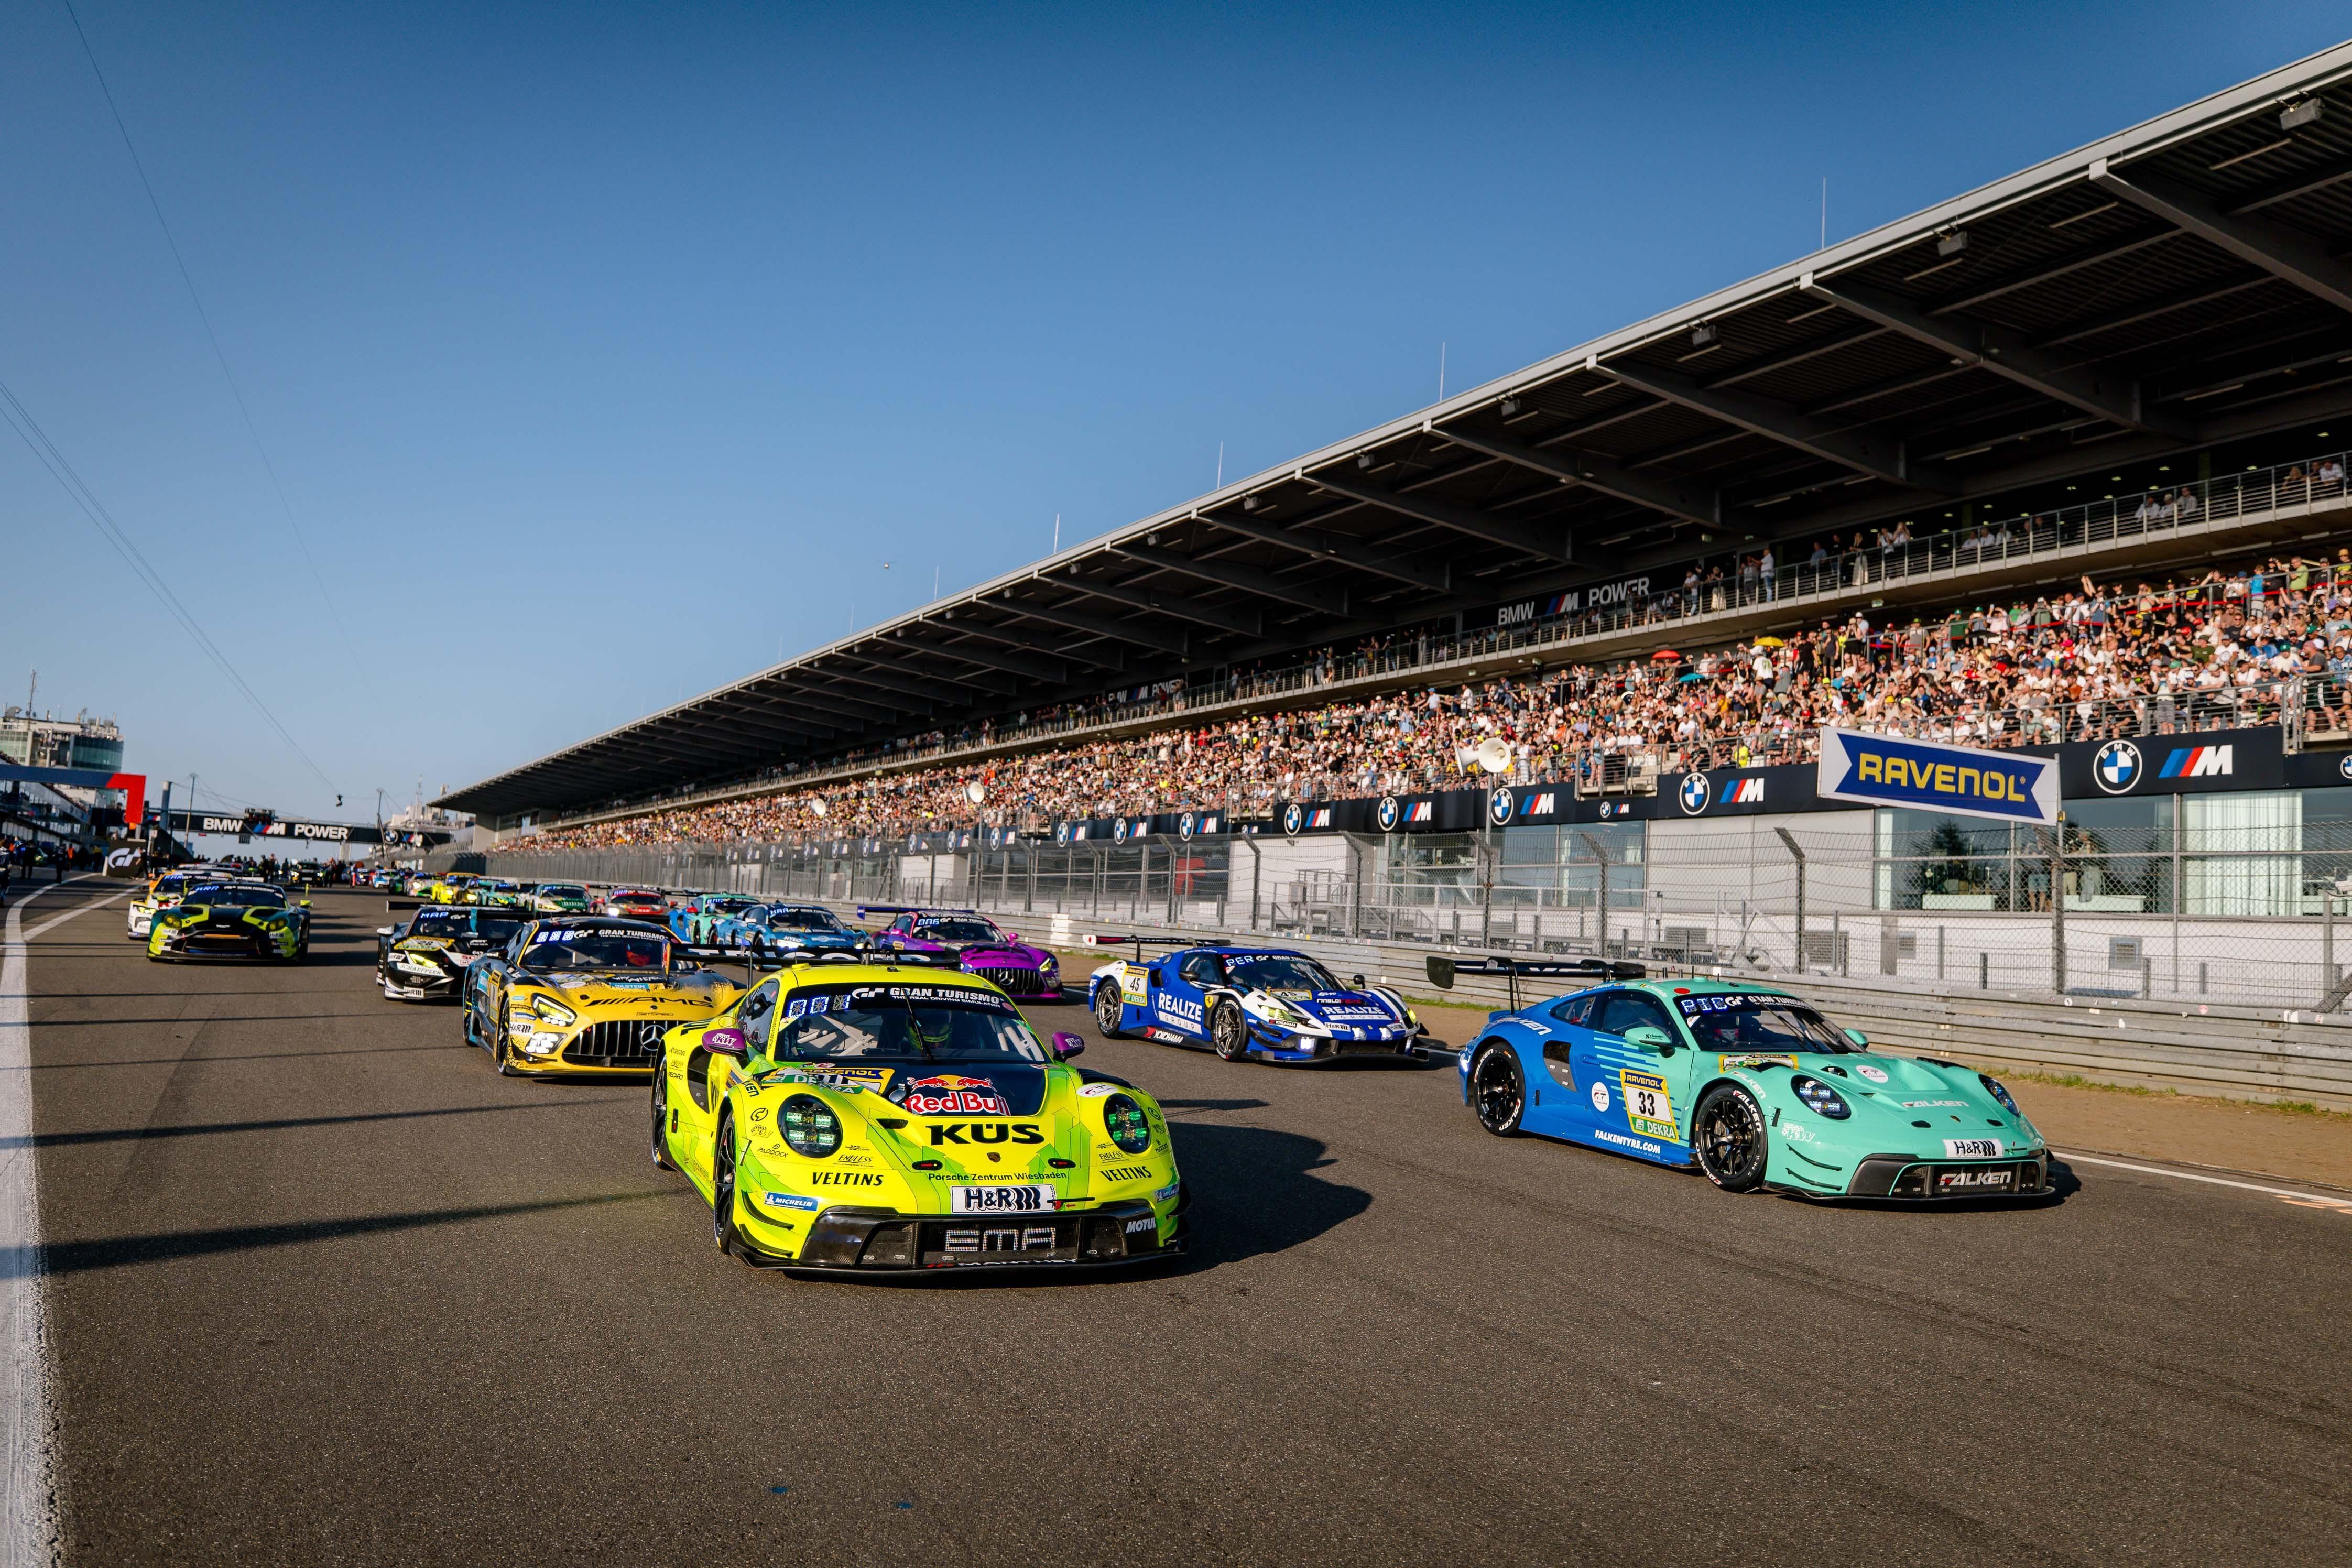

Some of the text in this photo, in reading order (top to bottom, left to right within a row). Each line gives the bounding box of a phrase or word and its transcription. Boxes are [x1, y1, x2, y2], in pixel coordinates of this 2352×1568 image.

[1498, 601, 1534, 625] BMW
[1588, 578, 1650, 607] POWER
[2101, 743, 2136, 759] BMW
[1684, 775, 1707, 787] BMW
[1859, 753, 2026, 802] RAVENOL
[203, 817, 243, 832] BMW
[294, 823, 349, 840] POWER
[626, 930, 665, 940] TURISMO
[1225, 955, 1254, 966] PER
[400, 963, 442, 975] SCHAEFFLER
[1130, 977, 1141, 992] 45
[629, 997, 714, 1008] AMG
[890, 987, 932, 997] GRAN
[937, 988, 1000, 1005] TURISMO
[961, 998, 1001, 1008] SIMULATOR
[1131, 995, 1146, 1004] DEKRA
[1158, 992, 1203, 1022] REALIZE
[1322, 1006, 1385, 1015] REALIZE
[509, 1023, 521, 1032] H&R
[1164, 1014, 1195, 1031] GROUP
[715, 1035, 737, 1046] KW
[1153, 1029, 1184, 1044] YOKOHAMA
[1474, 1048, 1494, 1083] FALKEN
[668, 1071, 683, 1080] RECARO
[1627, 1075, 1661, 1088] RAVENOL
[1732, 1071, 1767, 1100] FALKEN
[906, 1091, 1011, 1116] Red Bull
[1638, 1091, 1656, 1117] 33
[1499, 1098, 1521, 1131] FALKEN
[1733, 1090, 1762, 1133] FALKEN
[925, 1123, 1045, 1146] KÜS
[1647, 1121, 1676, 1139] DEKRA
[1594, 1129, 1661, 1155] FALKENTYRE.COM
[1954, 1140, 1982, 1156] H&R
[757, 1147, 789, 1158] PADDOCK
[839, 1153, 874, 1163] ENDLESS
[1098, 1150, 1124, 1160] ENDLESS
[1695, 1142, 1723, 1186] FALKEN
[812, 1172, 884, 1186] VELTINS
[928, 1173, 970, 1181] Porsche
[1015, 1171, 1068, 1180] Wiesbaden
[1099, 1166, 1153, 1182] VELTINS
[1939, 1171, 2012, 1186] FALKEN
[775, 1197, 814, 1208] MICHELIN
[965, 1188, 1016, 1210] H&R
[1126, 1217, 1157, 1233] MOTUL
